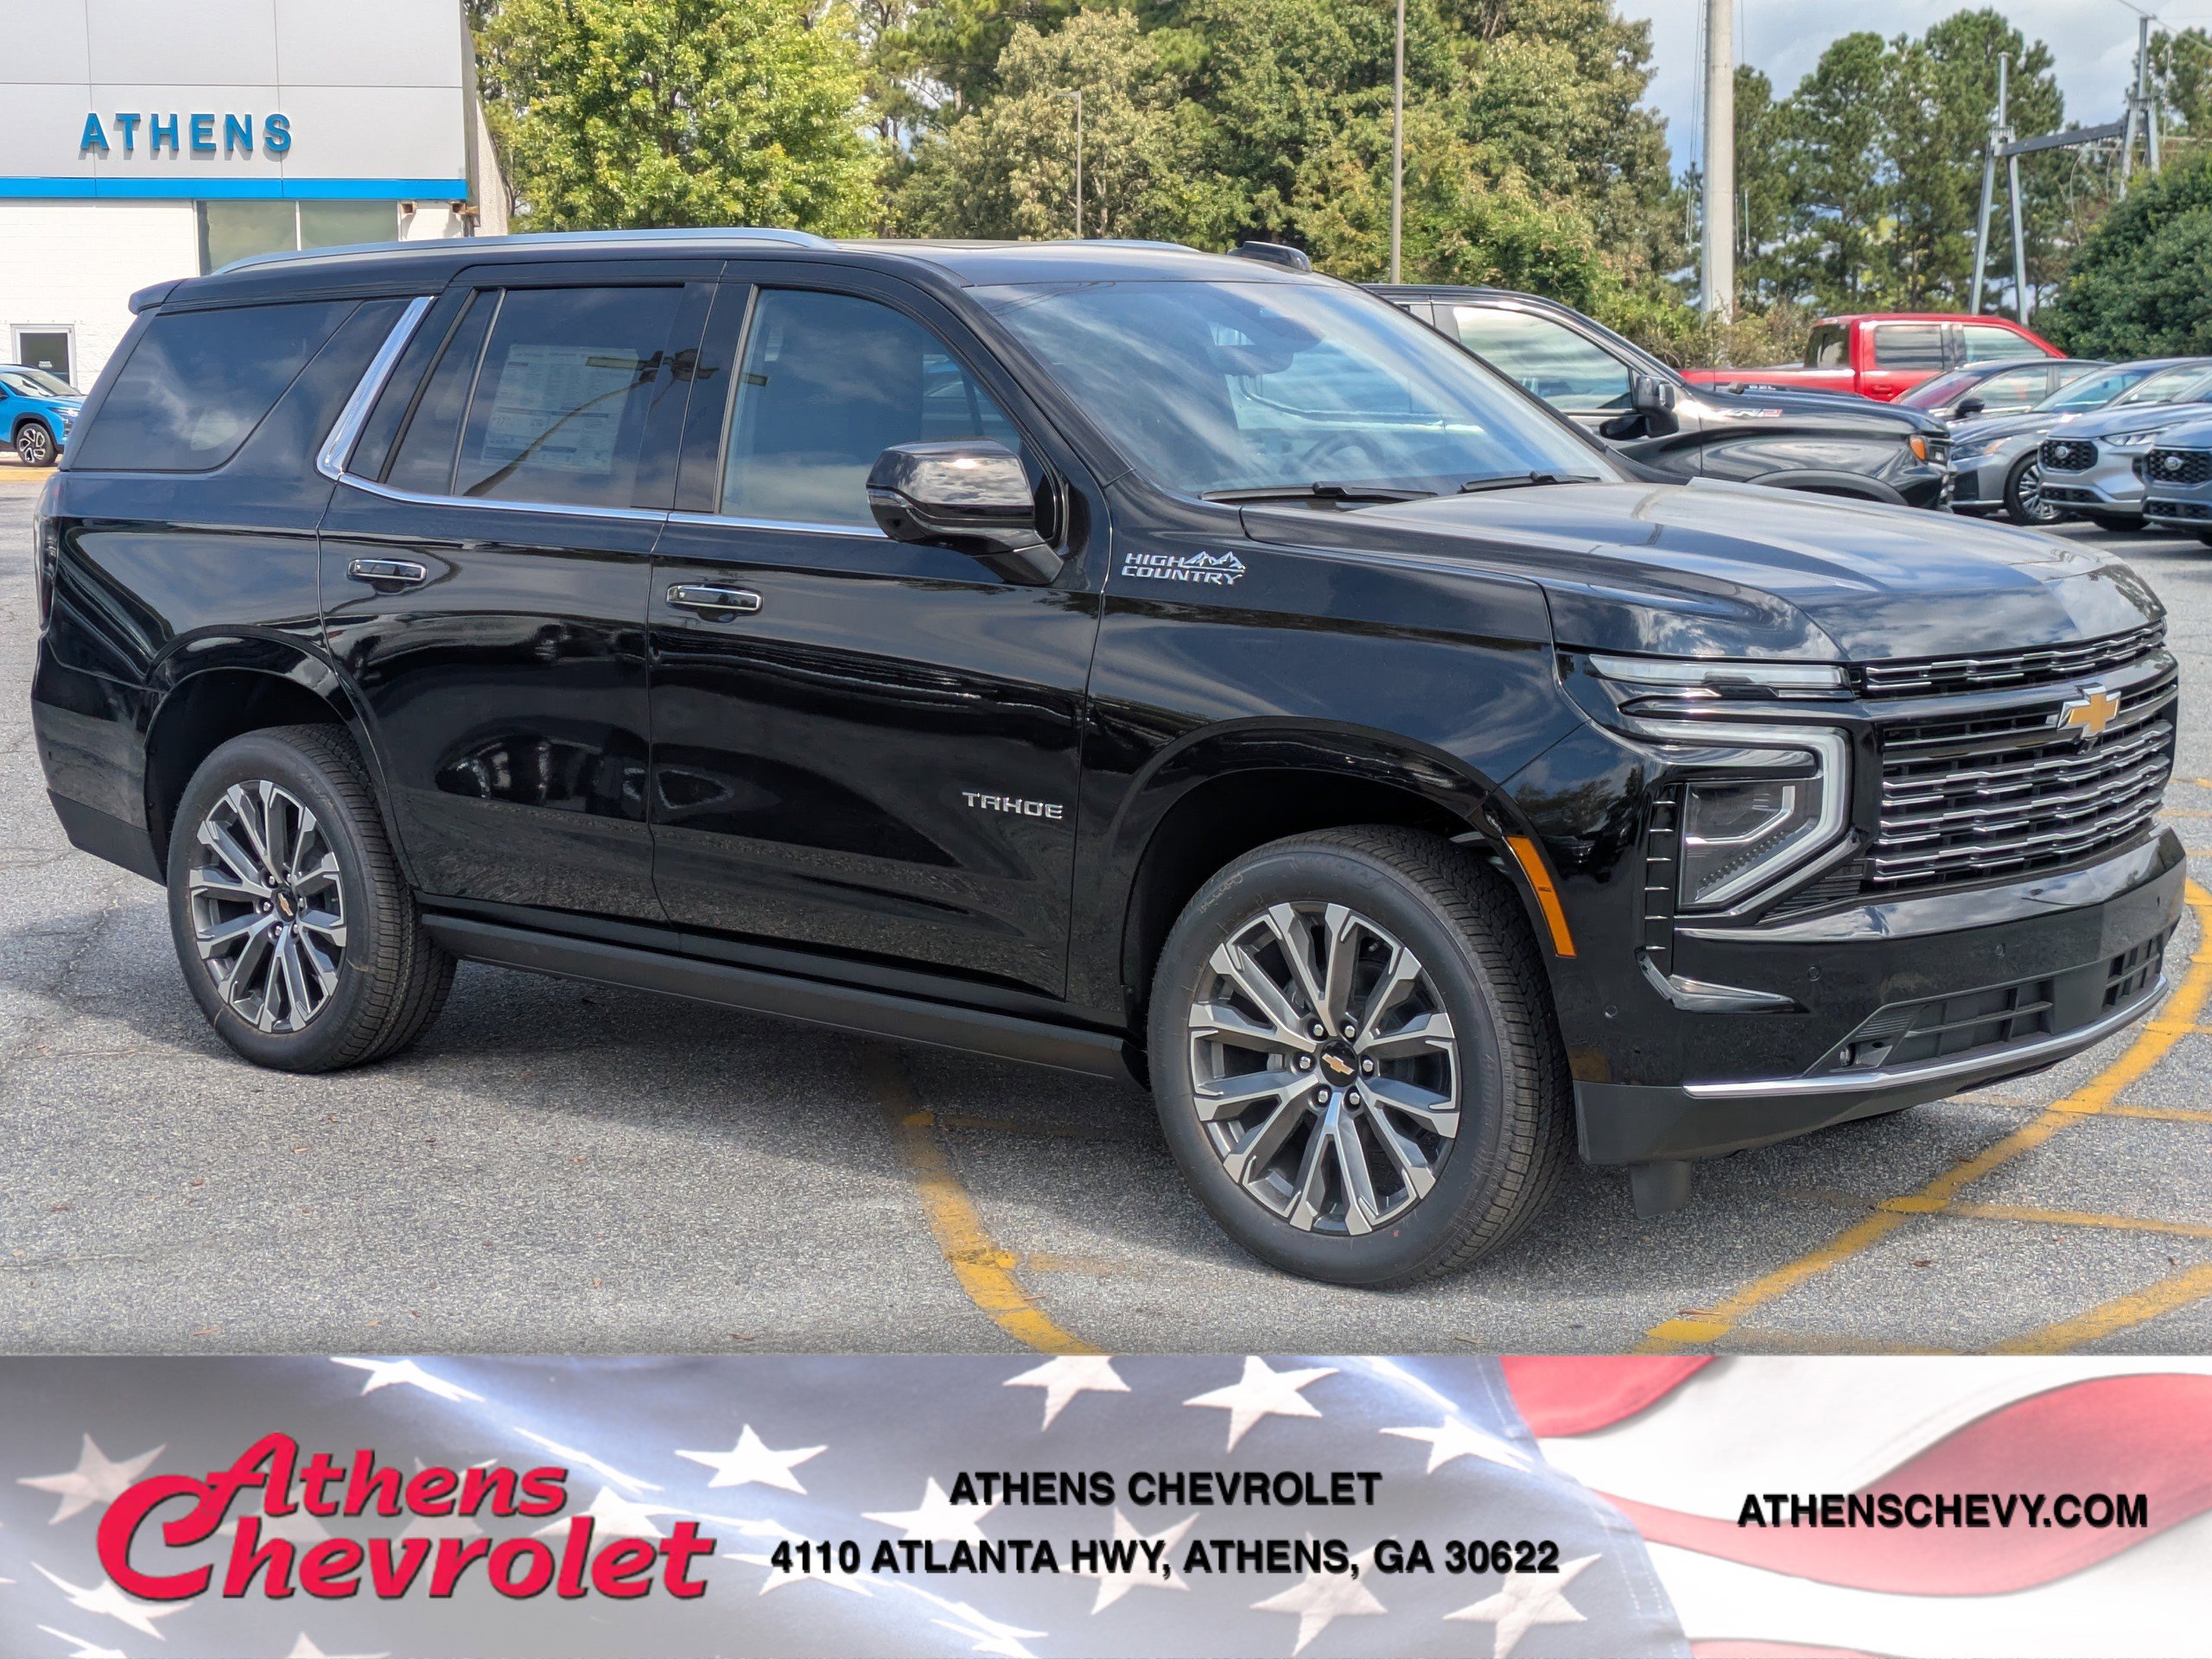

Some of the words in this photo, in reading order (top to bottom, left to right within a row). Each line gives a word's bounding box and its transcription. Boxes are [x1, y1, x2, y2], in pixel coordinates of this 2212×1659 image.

[80, 112, 292, 152] ATHENS
[1124, 552, 1185, 568] HIGH
[1121, 565, 1244, 586] COUNTRY
[962, 791, 1064, 820] TAHOE
